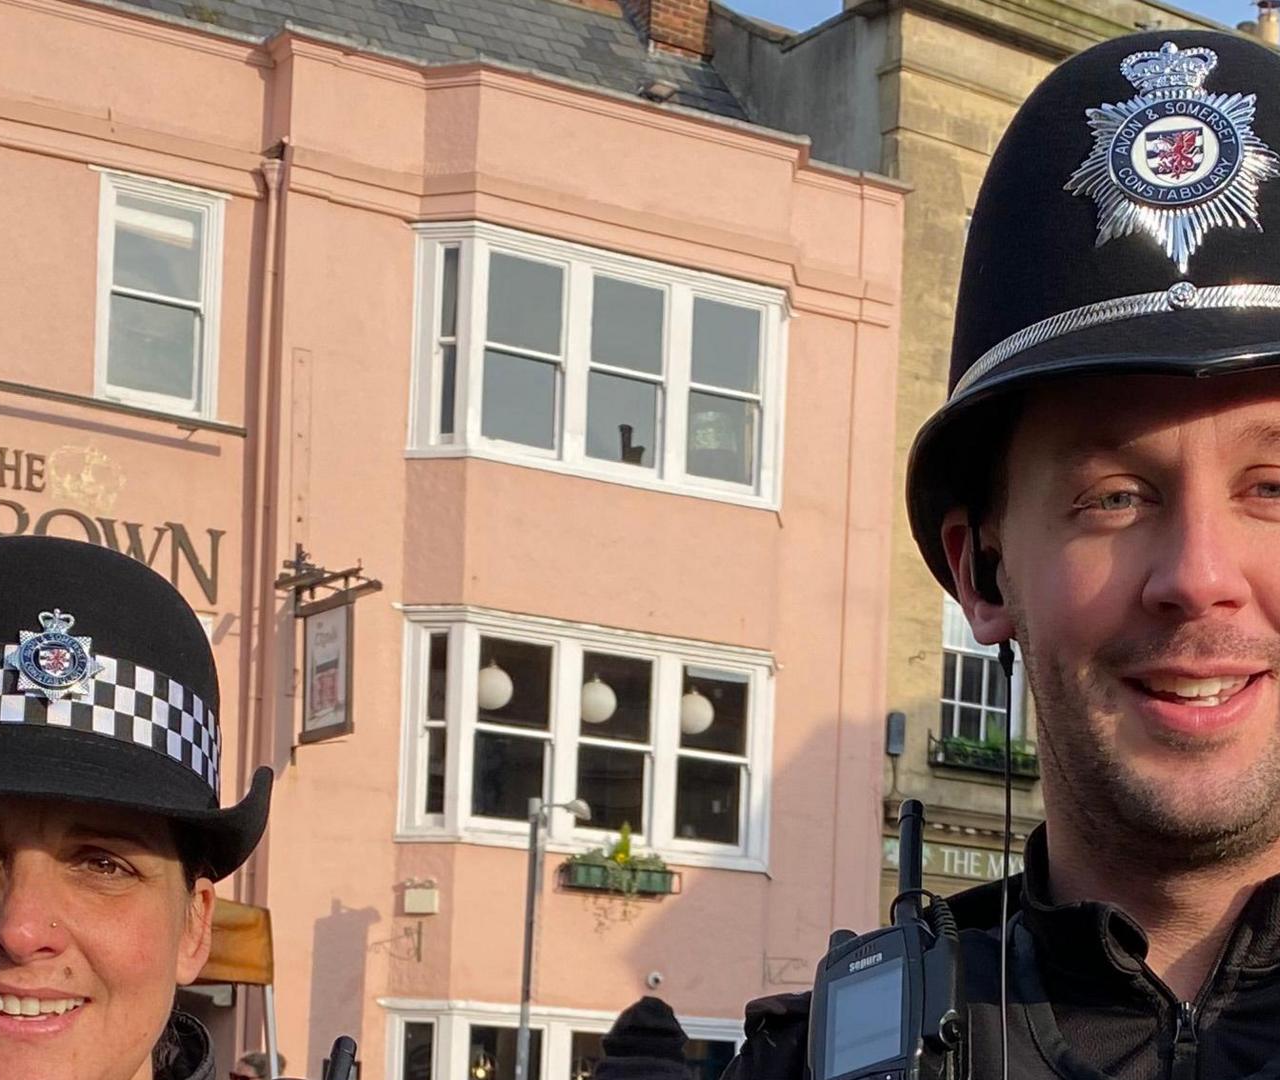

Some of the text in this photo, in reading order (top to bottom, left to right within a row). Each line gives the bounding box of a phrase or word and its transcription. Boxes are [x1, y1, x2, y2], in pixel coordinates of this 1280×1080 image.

[1115, 101, 1236, 156] AVON & SOMERSET
[1118, 157, 1234, 200] CONSTABULARY
[940, 847, 982, 877] THE
